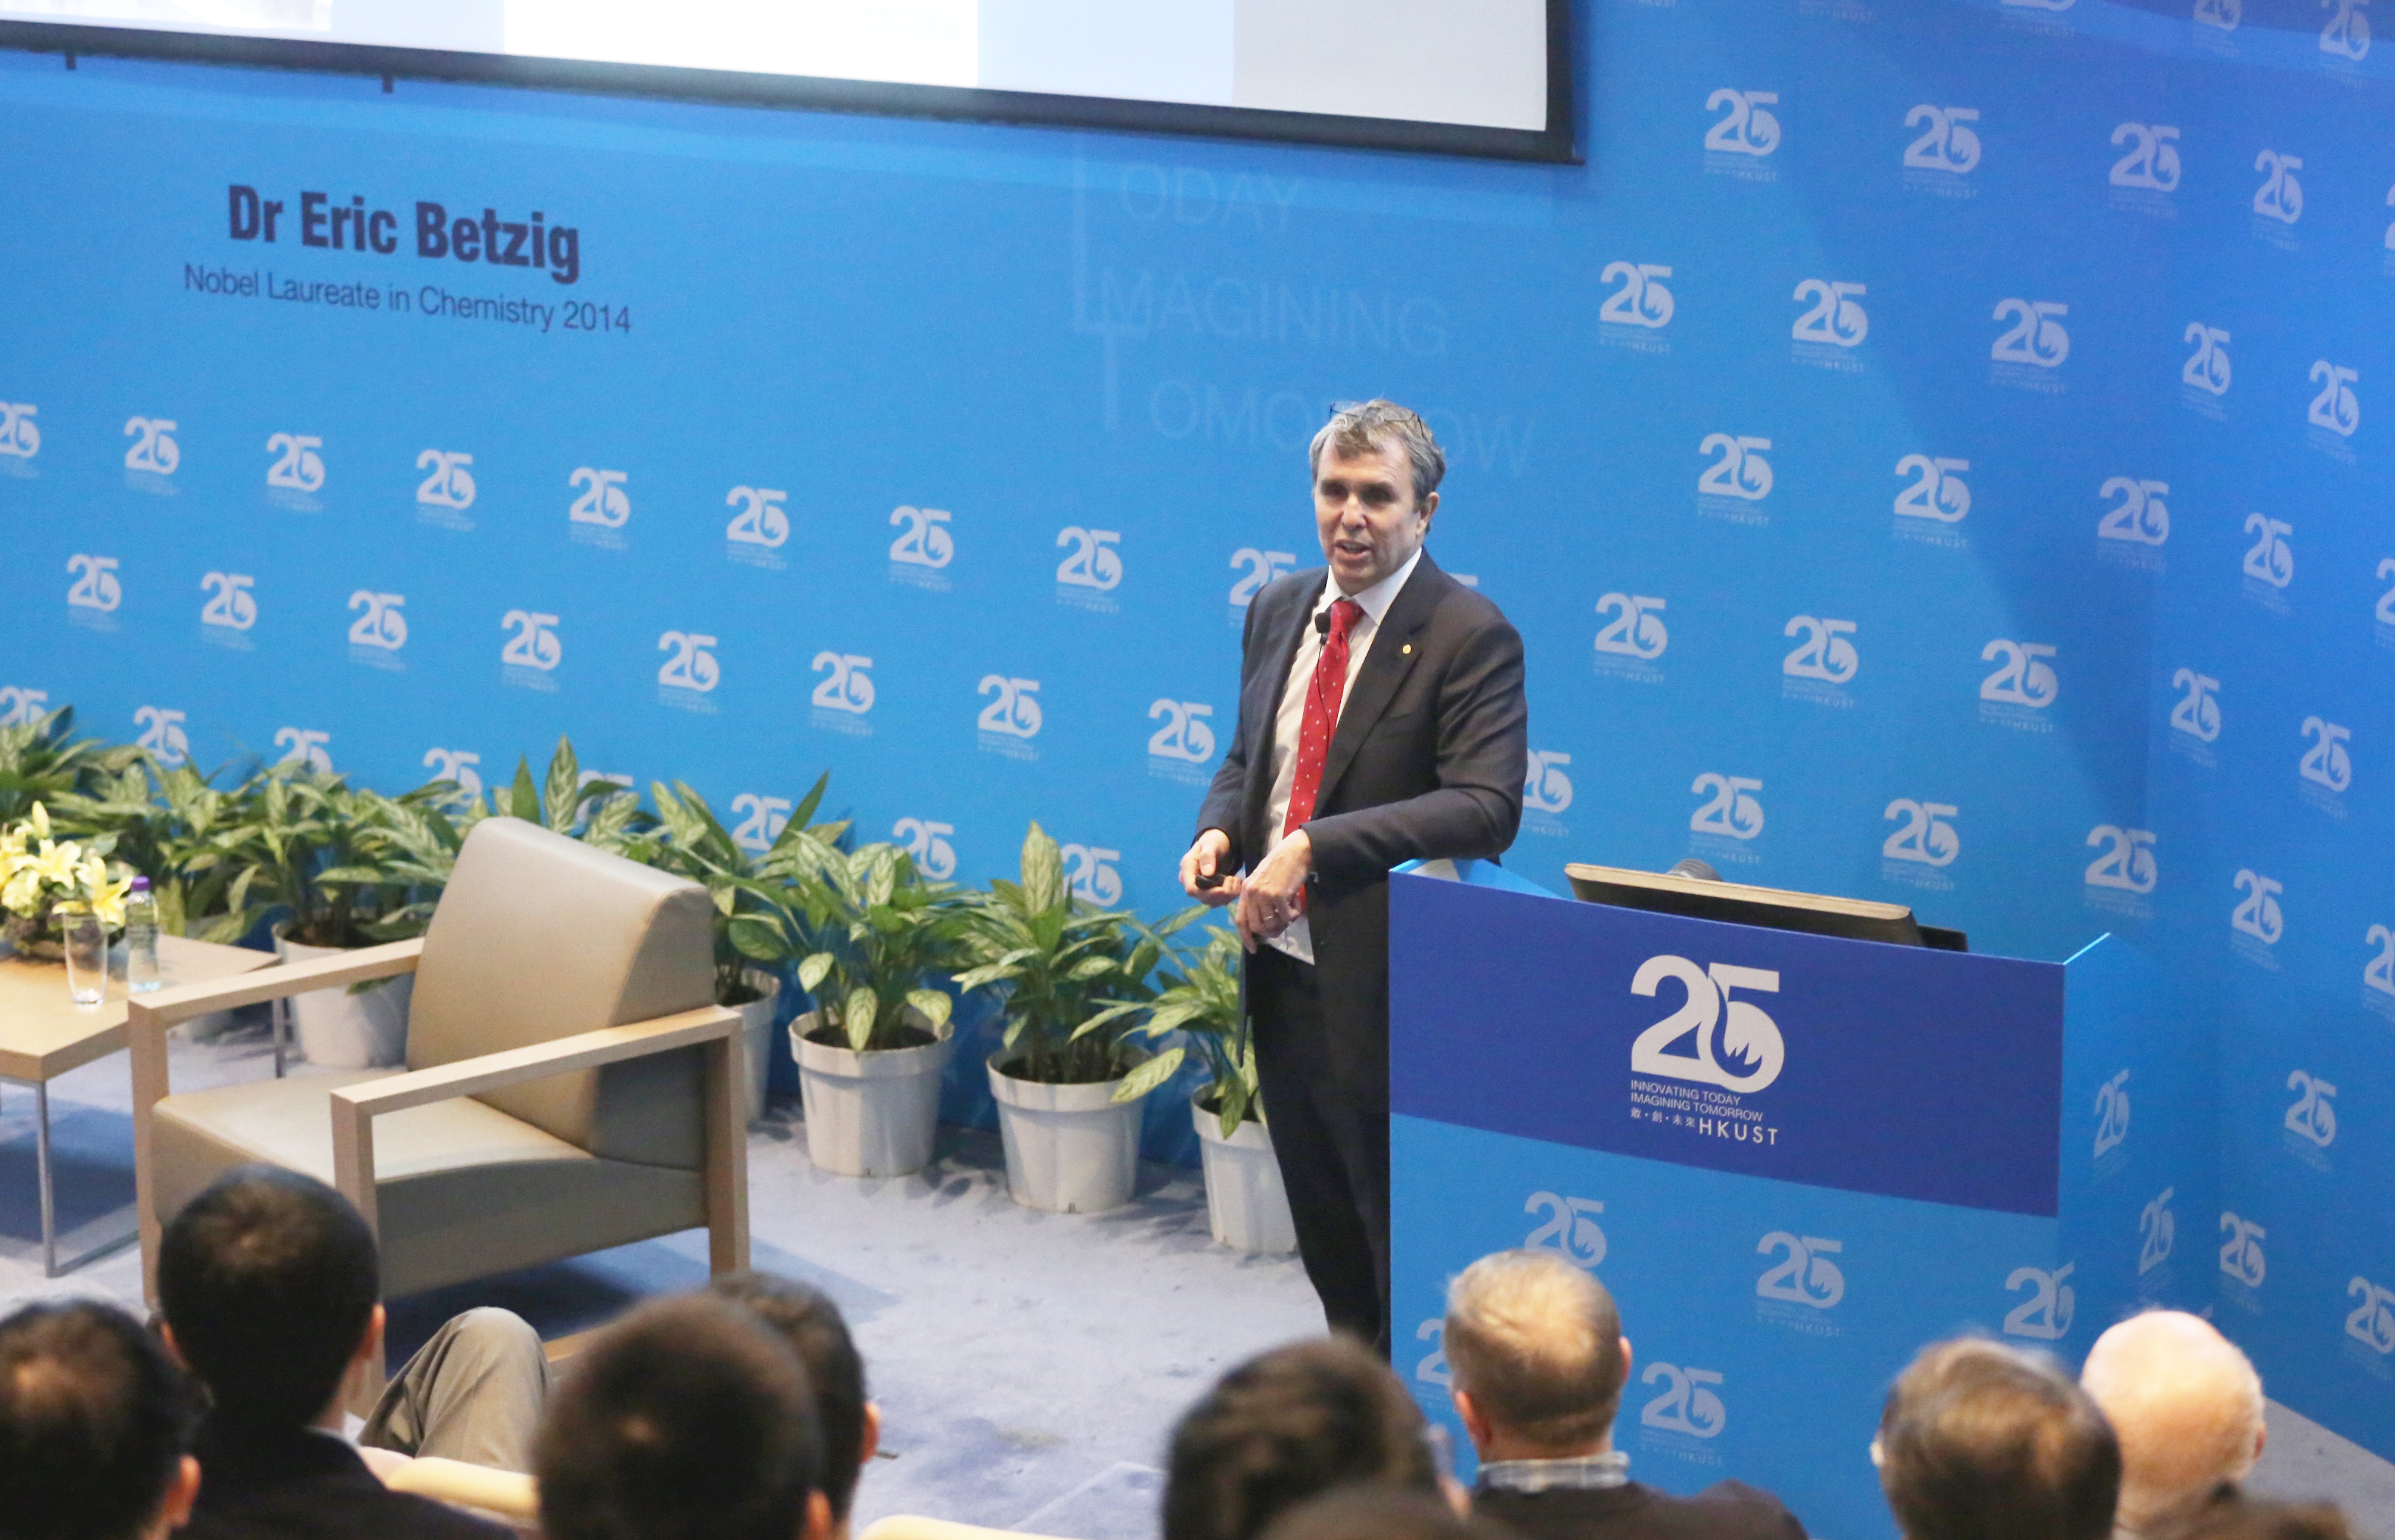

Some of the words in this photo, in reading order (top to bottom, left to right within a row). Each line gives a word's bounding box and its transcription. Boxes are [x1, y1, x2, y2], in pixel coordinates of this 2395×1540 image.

[1705, 88, 1780, 156] 25
[1905, 105, 1981, 173] 25
[2110, 124, 2180, 192] 25
[2253, 150, 2303, 223] 25
[229, 184, 284, 243] Dr
[301, 190, 398, 255] Eric
[415, 201, 581, 285] Betzig
[184, 263, 259, 298] Nobel
[268, 271, 381, 310] Laureate
[388, 283, 411, 312] in
[419, 285, 554, 333] Chemistry
[564, 300, 631, 334] 2014
[1600, 261, 1674, 328] 25
[1793, 279, 1868, 346] 25
[1992, 299, 2068, 367] 25
[2183, 322, 2231, 395] 25
[2308, 360, 2359, 436] 25
[124, 416, 180, 475] 25
[266, 433, 325, 492] 25
[1698, 433, 1773, 500] 25
[416, 449, 476, 510] 25
[569, 467, 631, 529] 25
[1894, 454, 1971, 522] 25
[2099, 478, 2169, 546] 25
[726, 485, 789, 548] 25
[890, 506, 954, 568] 25
[2243, 512, 2293, 588] 25
[67, 554, 122, 612] 25
[1056, 526, 1123, 590] 25
[201, 571, 257, 630] 25
[348, 590, 408, 650] 25
[1594, 593, 1667, 659] 25
[501, 610, 562, 671] 25
[658, 630, 719, 692] 25
[1783, 616, 1858, 683] 25
[1980, 639, 2057, 708] 25
[812, 651, 875, 714] 25
[977, 675, 1042, 738] 25
[2171, 668, 2220, 742] 25
[1148, 699, 1215, 763] 25
[2299, 716, 2352, 792] 25
[1690, 773, 1764, 839] 25
[1883, 799, 1959, 866] 25
[2085, 825, 2157, 893] 25
[2232, 869, 2283, 944] 25
[1631, 955, 1785, 1093] 25
[1631, 1079, 1699, 1100] INNOVATING
[1702, 1090, 1741, 1106] TODAY
[1631, 1092, 1690, 1111] IMAGINING
[1693, 1102, 1763, 1122] TOMORROW
[2285, 1070, 2336, 1147] 25
[1699, 1117, 1778, 1146] HKUST
[1757, 1231, 1844, 1309] 25
[2220, 1211, 2265, 1288] 25
[1643, 1362, 1725, 1438] 25
